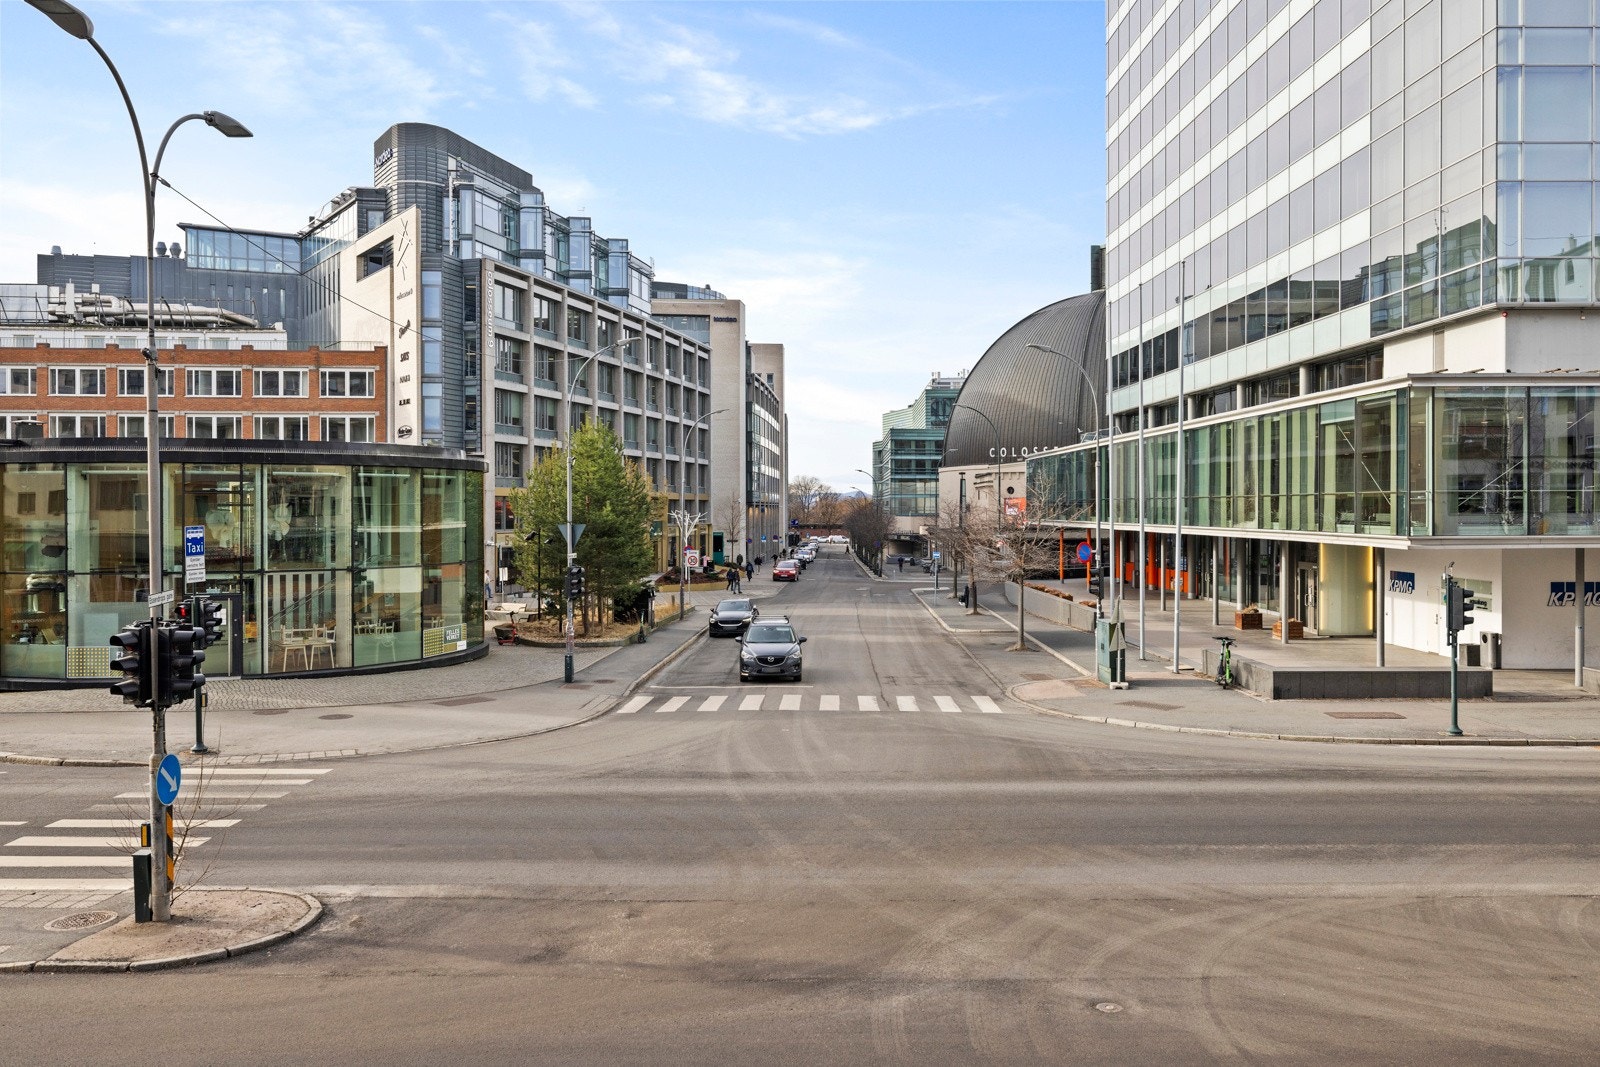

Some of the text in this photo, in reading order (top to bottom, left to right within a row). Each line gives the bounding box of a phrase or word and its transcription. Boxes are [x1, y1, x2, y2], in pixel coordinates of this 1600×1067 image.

[989, 446, 1059, 458] COLOSS
[187, 542, 204, 553] Taxi
[1389, 579, 1413, 594] KPMG
